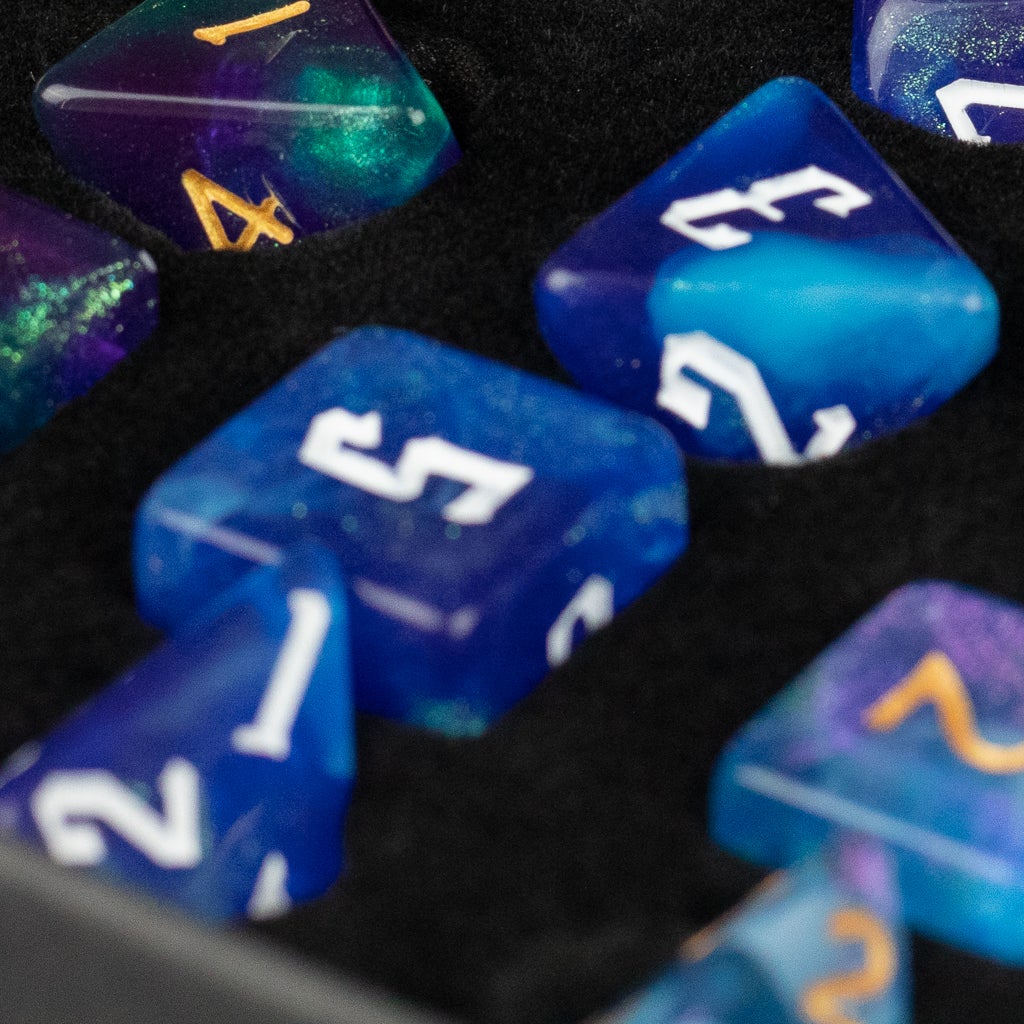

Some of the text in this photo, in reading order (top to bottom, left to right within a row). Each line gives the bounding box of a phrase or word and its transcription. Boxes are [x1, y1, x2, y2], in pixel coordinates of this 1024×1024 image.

[181, 168, 294, 252] 4
[660, 164, 872, 250] 3
[298, 406, 533, 525] 5
[231, 588, 332, 762] 1
[30, 756, 201, 868] 2
